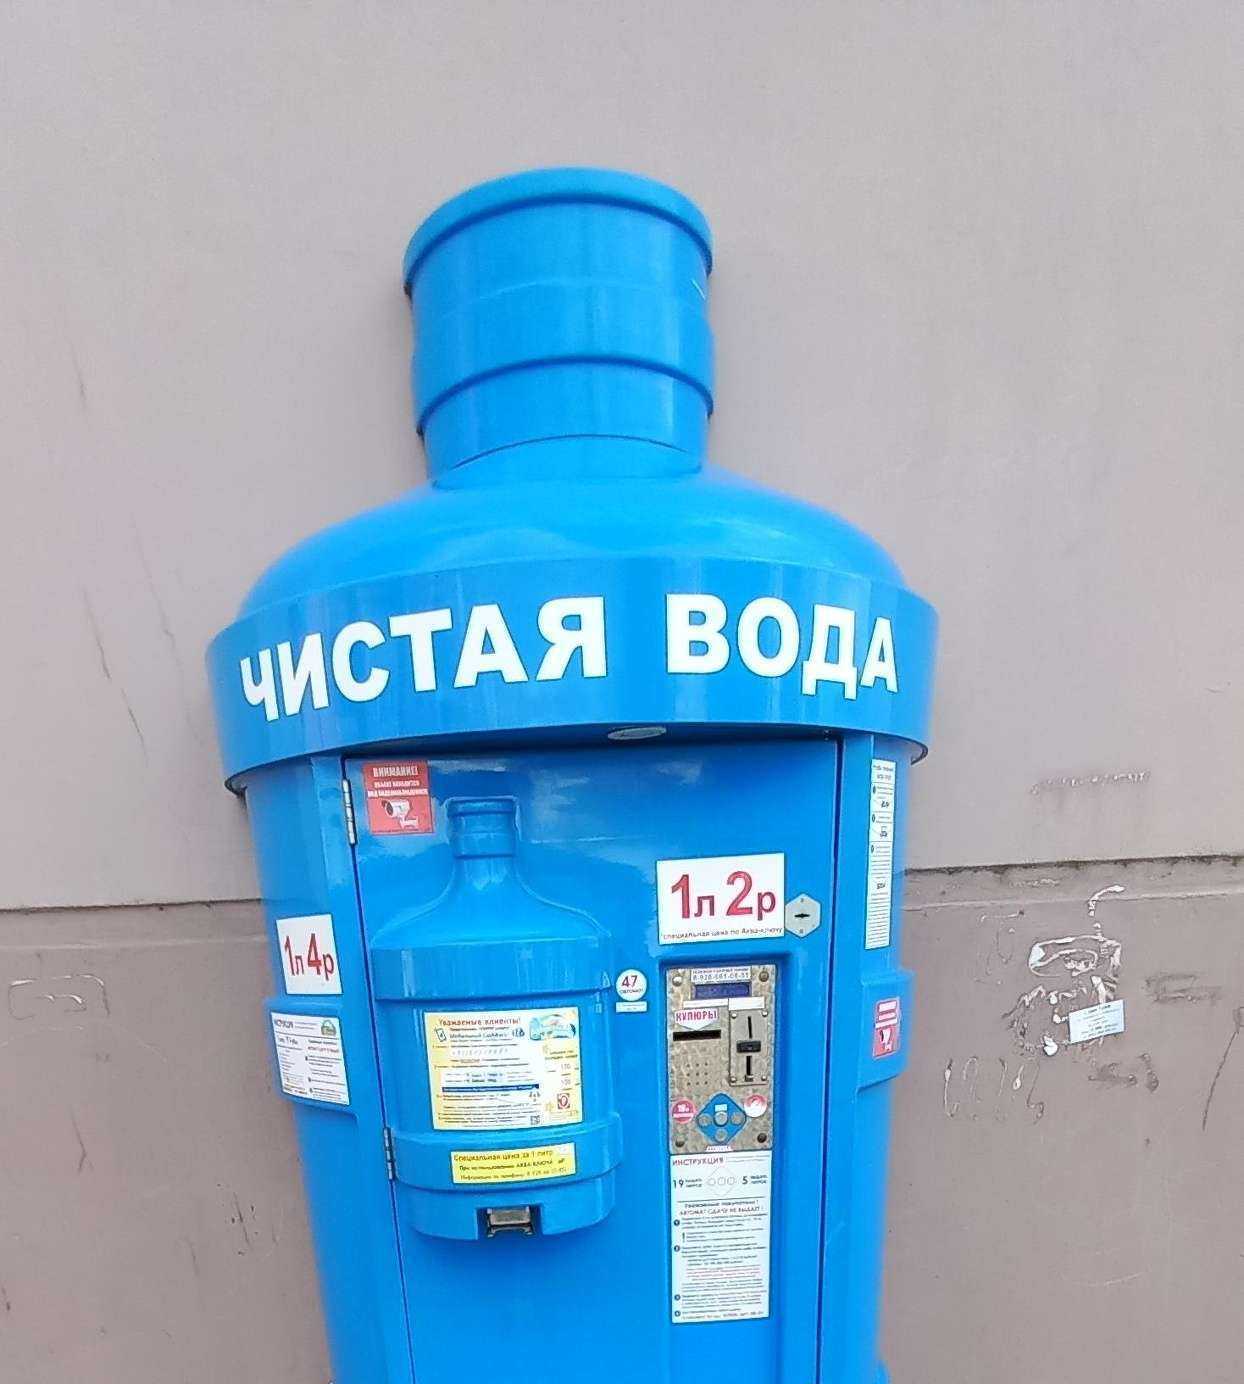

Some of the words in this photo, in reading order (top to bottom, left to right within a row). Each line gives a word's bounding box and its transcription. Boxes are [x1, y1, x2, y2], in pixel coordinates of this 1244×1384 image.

[239, 595, 608, 722] ЧИСТАЯ
[665, 593, 899, 700] ВОДА
[621, 974, 638, 987] 47
[675, 1010, 717, 1022] КУПЮРЫ
[672, 1156, 724, 1166] ИНСТРУКЦИЯ
[672, 1178, 684, 1190] 19
[742, 1175, 749, 1185] 5
